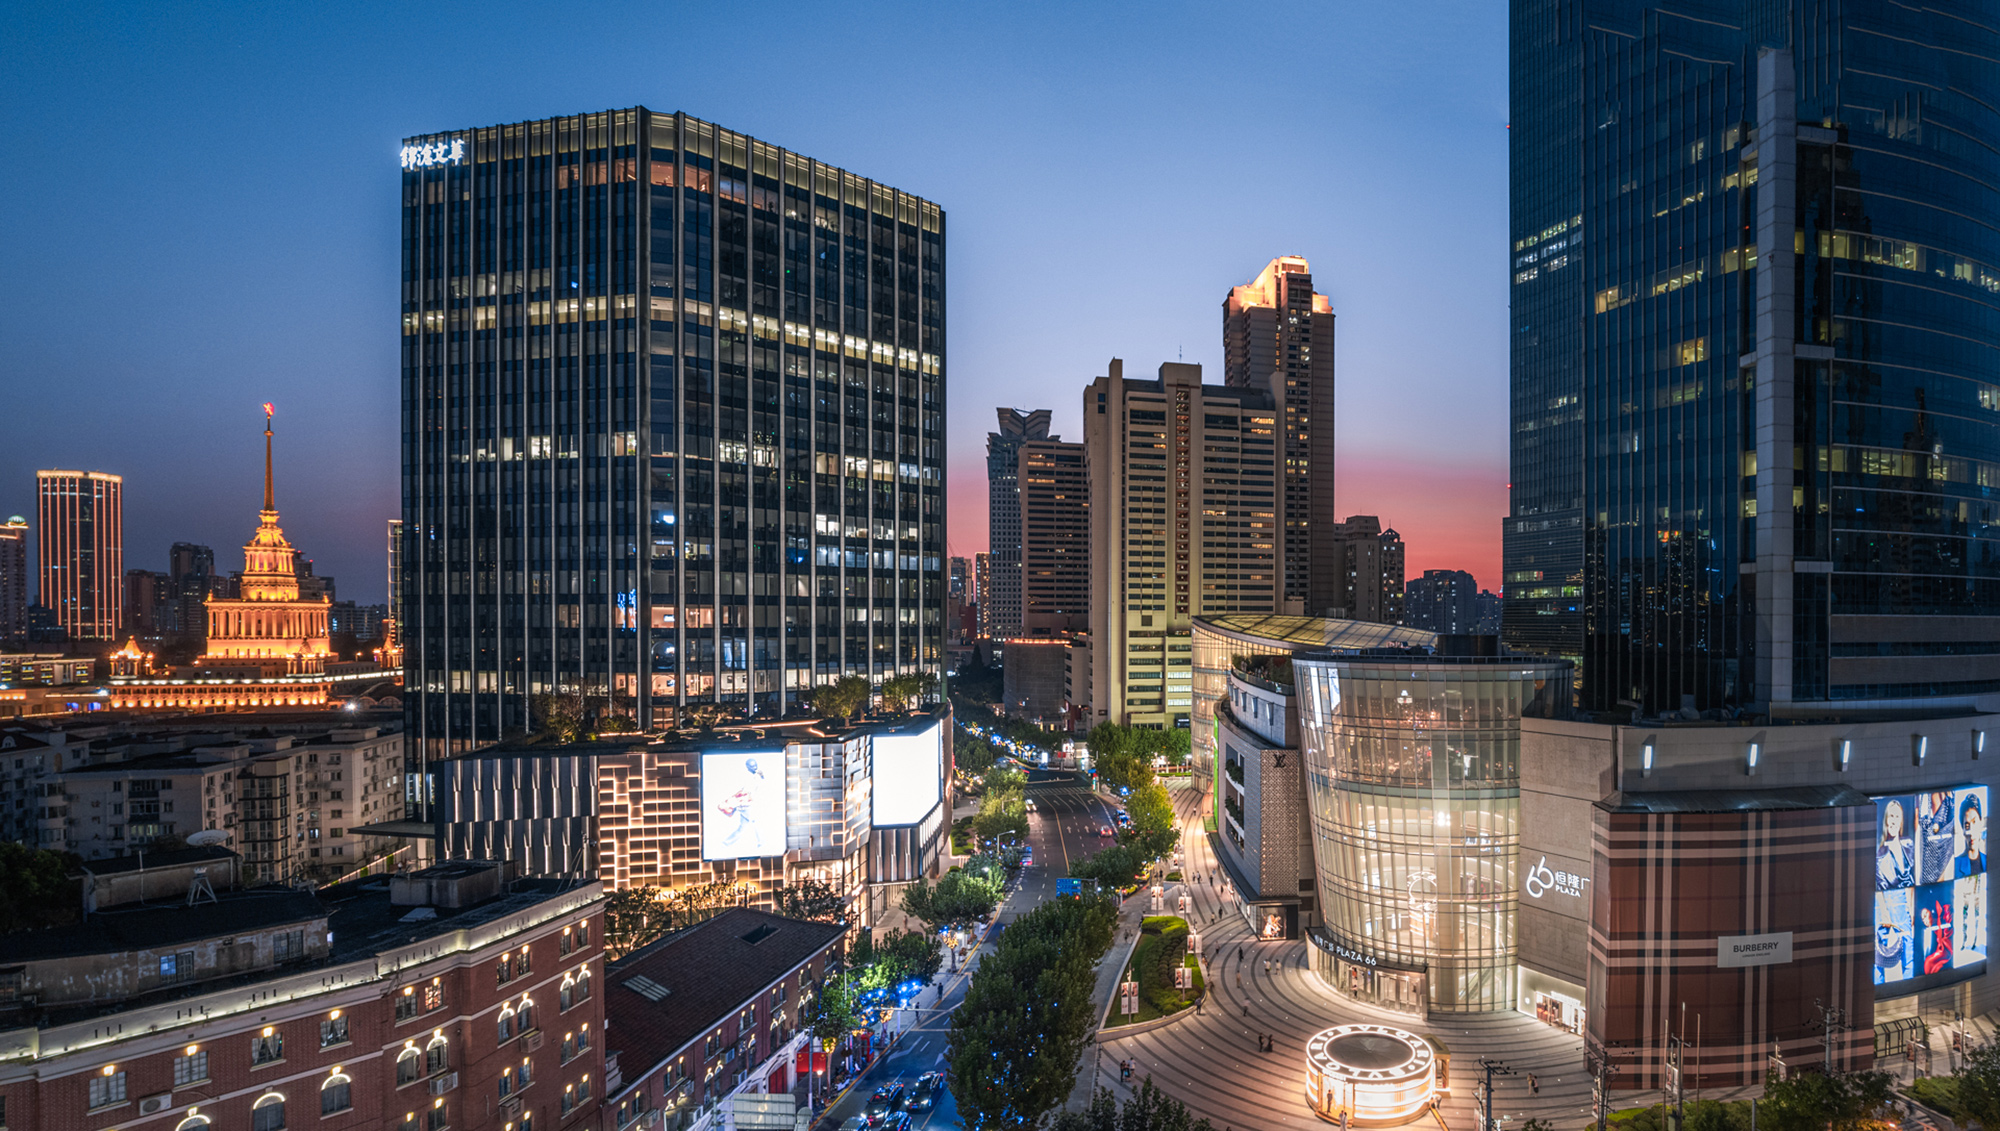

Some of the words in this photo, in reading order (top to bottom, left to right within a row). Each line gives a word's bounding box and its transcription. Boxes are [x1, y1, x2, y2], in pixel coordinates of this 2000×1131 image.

[1555, 884, 1581, 898] PLAZA
[1733, 941, 1779, 953] BURBERRY
[1336, 945, 1363, 963] PLAZA
[1365, 955, 1377, 967] 66
